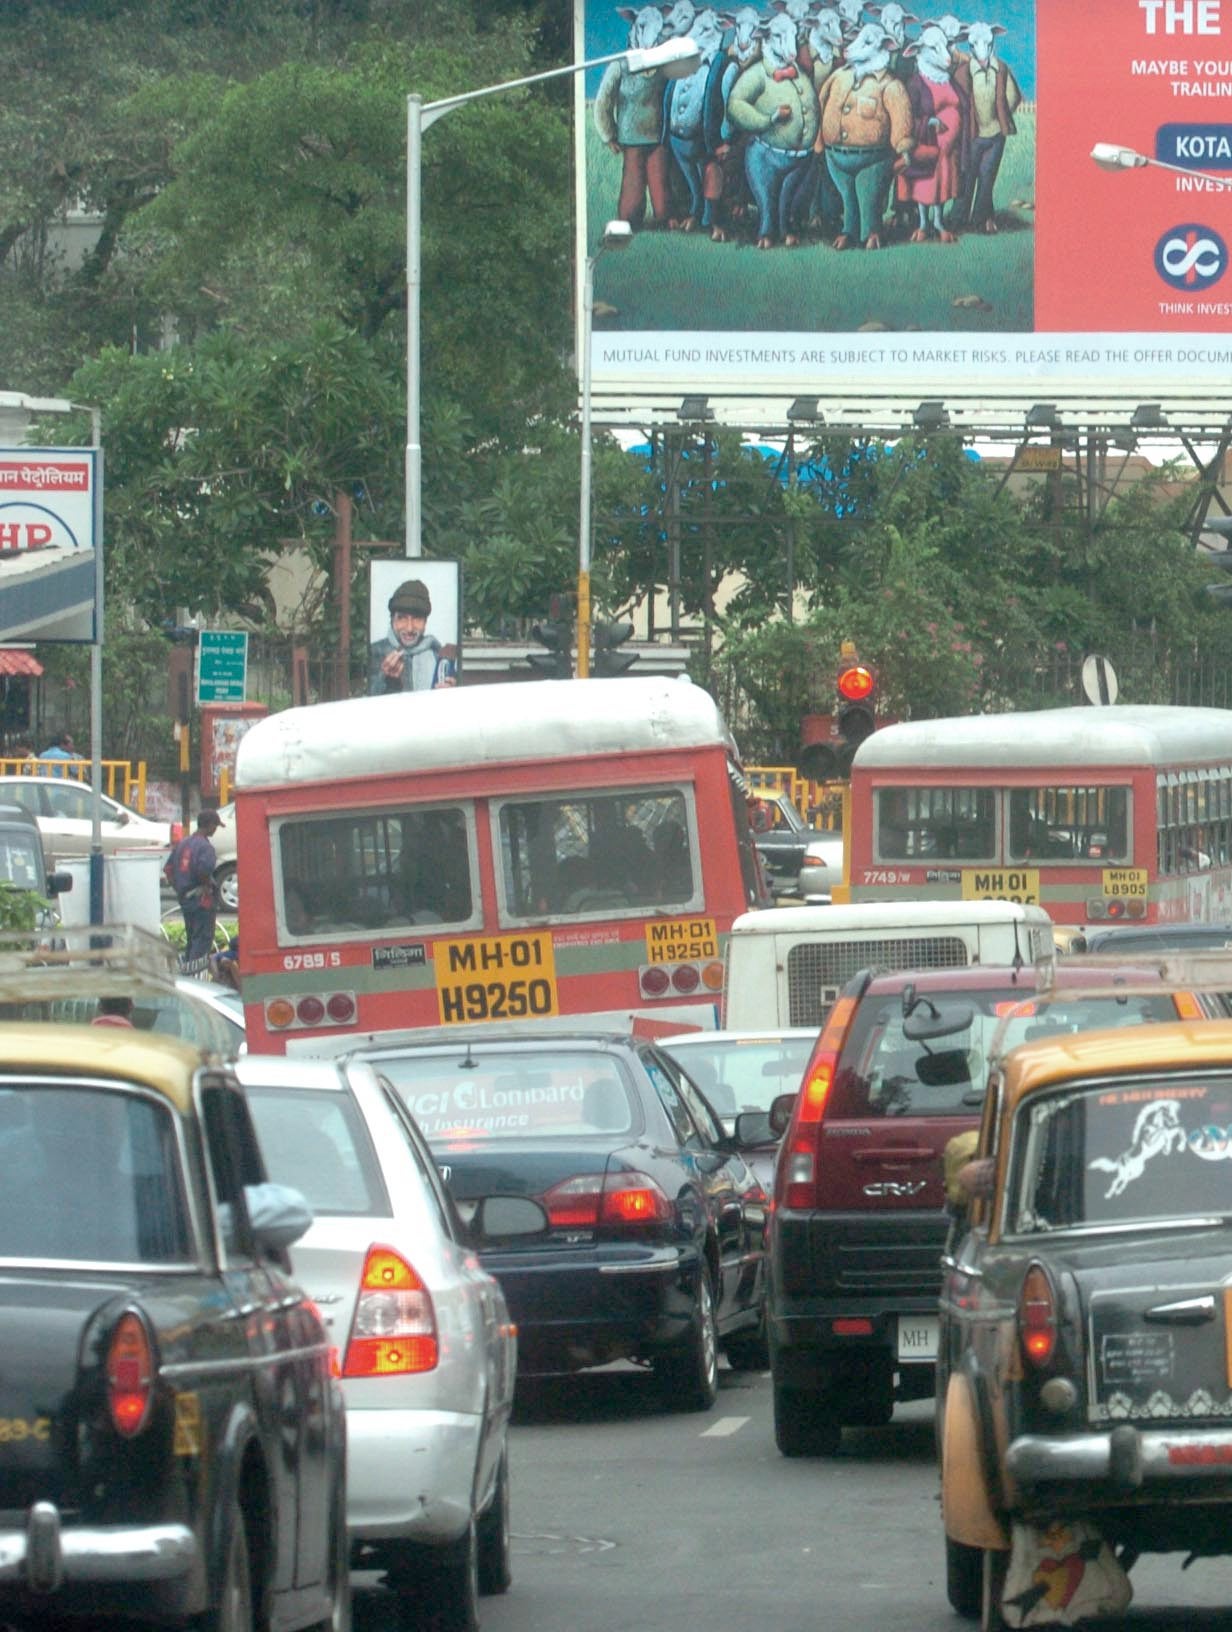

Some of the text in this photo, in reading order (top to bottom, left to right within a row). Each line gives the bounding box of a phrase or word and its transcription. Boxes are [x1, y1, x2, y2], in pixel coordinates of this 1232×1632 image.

[1139, 0, 1221, 35] THE
[1131, 60, 1188, 75] MAYBE
[1159, 303, 1193, 315] THINK
[603, 349, 660, 363] MUTUAL
[664, 349, 701, 363] FUND
[705, 349, 796, 363] INVESTMENTS
[800, 349, 825, 363] ARE
[830, 349, 885, 363] SUBJECT
[891, 349, 908, 363] TO
[912, 349, 966, 363] MARKET
[1016, 349, 1061, 363] PLEASE
[1066, 349, 1100, 363] READ
[1105, 349, 1129, 363] THE
[1133, 350, 1173, 364] OFFER
[0, 524, 52, 550] HP
[975, 874, 1003, 891] MH
[1110, 871, 1126, 881] MH
[651, 941, 715, 962] H9250
[440, 978, 552, 1022] H9250
[480, 1077, 585, 1110] Lombard
[863, 1181, 927, 1196] CR-V
[902, 1329, 928, 1347] MH
